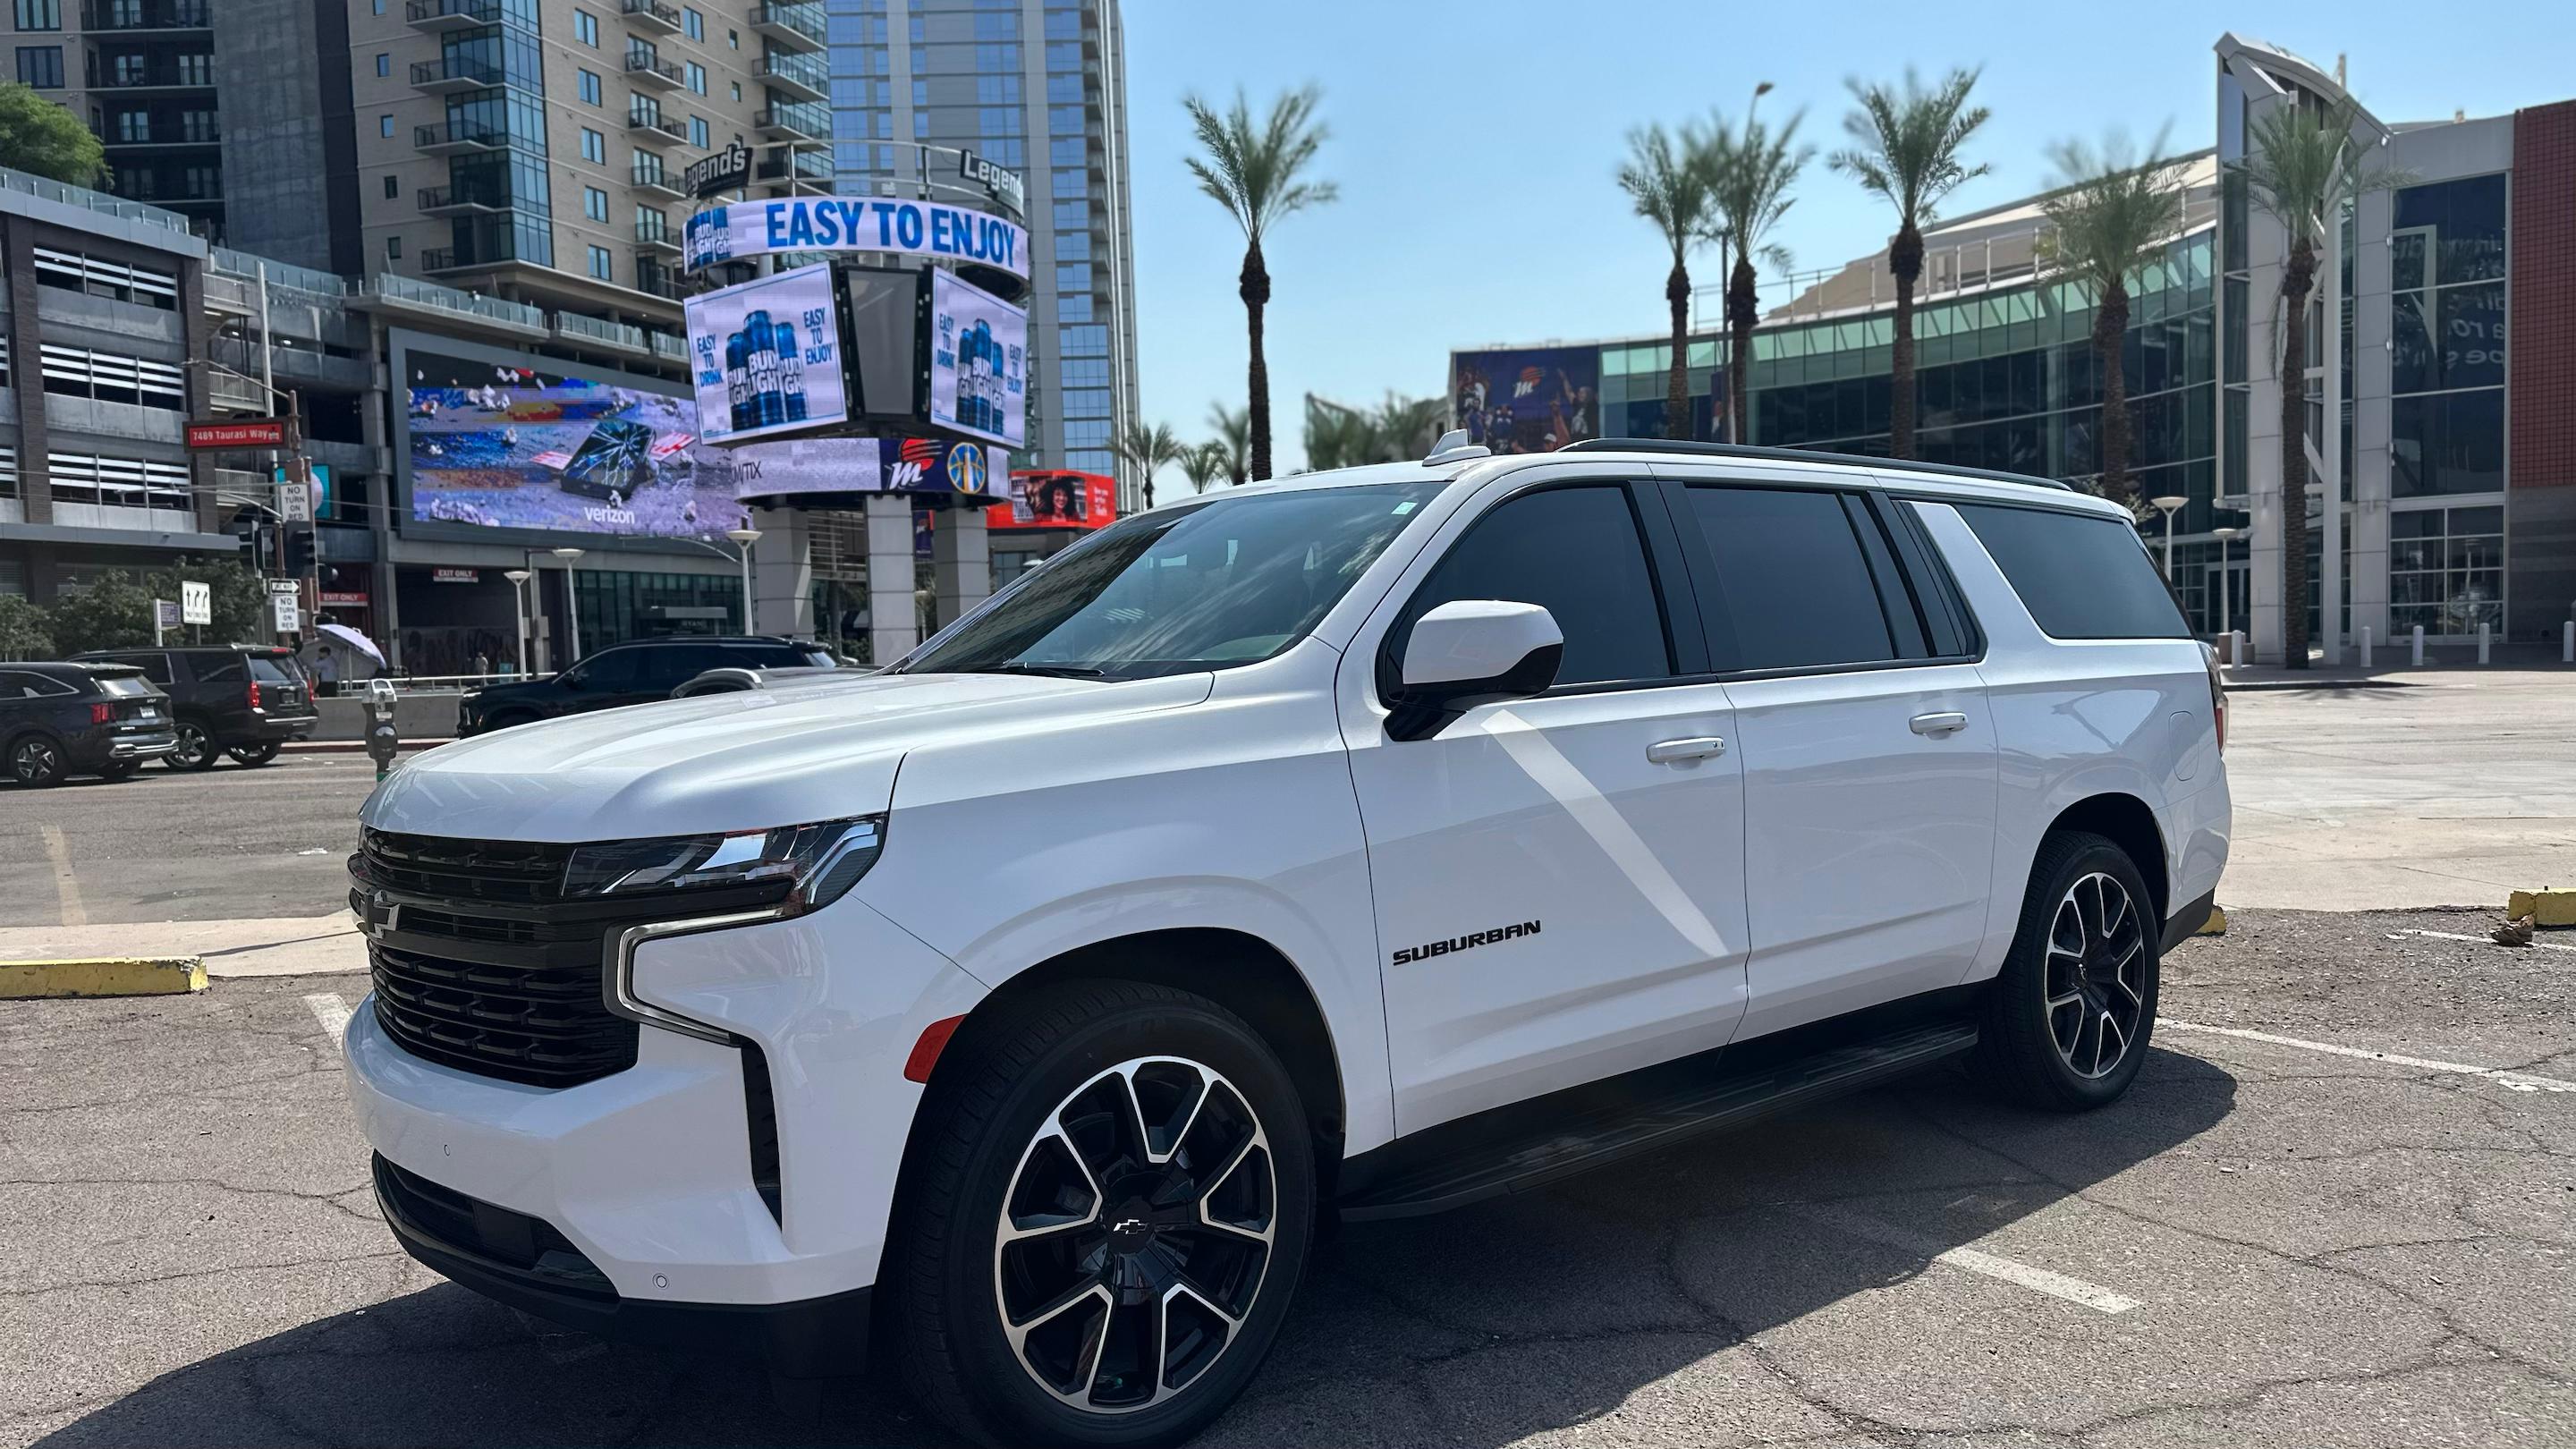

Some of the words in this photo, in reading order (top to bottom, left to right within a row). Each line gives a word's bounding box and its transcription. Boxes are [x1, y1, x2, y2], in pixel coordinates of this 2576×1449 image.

[766, 200, 864, 248] EASY
[871, 202, 923, 250] TO
[930, 207, 1015, 267] ENJOY
[803, 307, 826, 327] EASY
[697, 334, 716, 353] EASY
[810, 326, 823, 344] TO
[703, 353, 715, 369] TO
[748, 350, 776, 374] BUD
[805, 343, 833, 365] ENJOY
[699, 368, 724, 387] DRINK
[216, 428, 247, 439] Taurasi
[250, 428, 268, 440] Way
[284, 495, 305, 504] TURN
[287, 487, 301, 495] NO
[290, 504, 301, 513] ON
[583, 504, 635, 524] verizon
[280, 597, 292, 606] NO
[323, 593, 341, 601] EXIT
[279, 606, 295, 614] TURN
[1393, 919, 1541, 967] SUBURBAN
